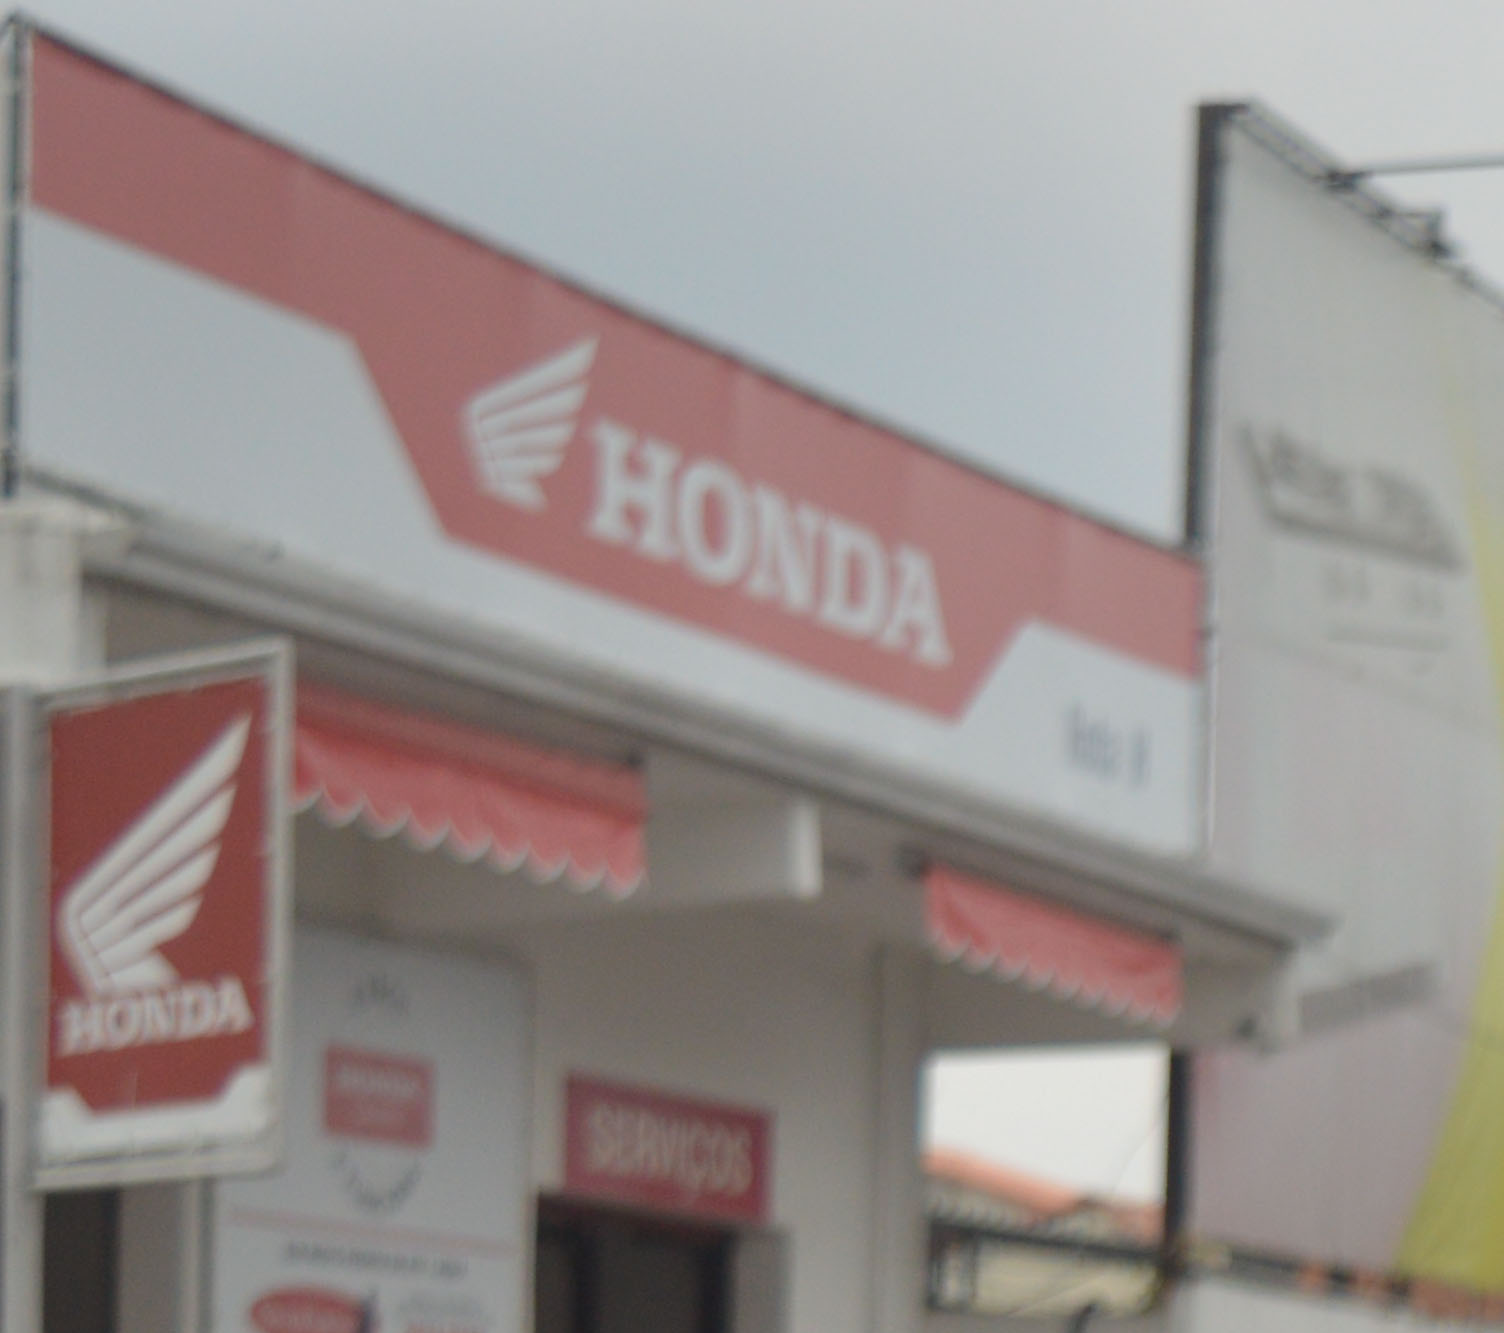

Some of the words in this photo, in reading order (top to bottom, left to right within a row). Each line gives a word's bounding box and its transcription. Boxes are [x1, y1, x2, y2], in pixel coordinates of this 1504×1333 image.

[584, 418, 953, 669] HONDA
[58, 974, 255, 1057] HONDA
[587, 1103, 754, 1199] SERVIÇOS
